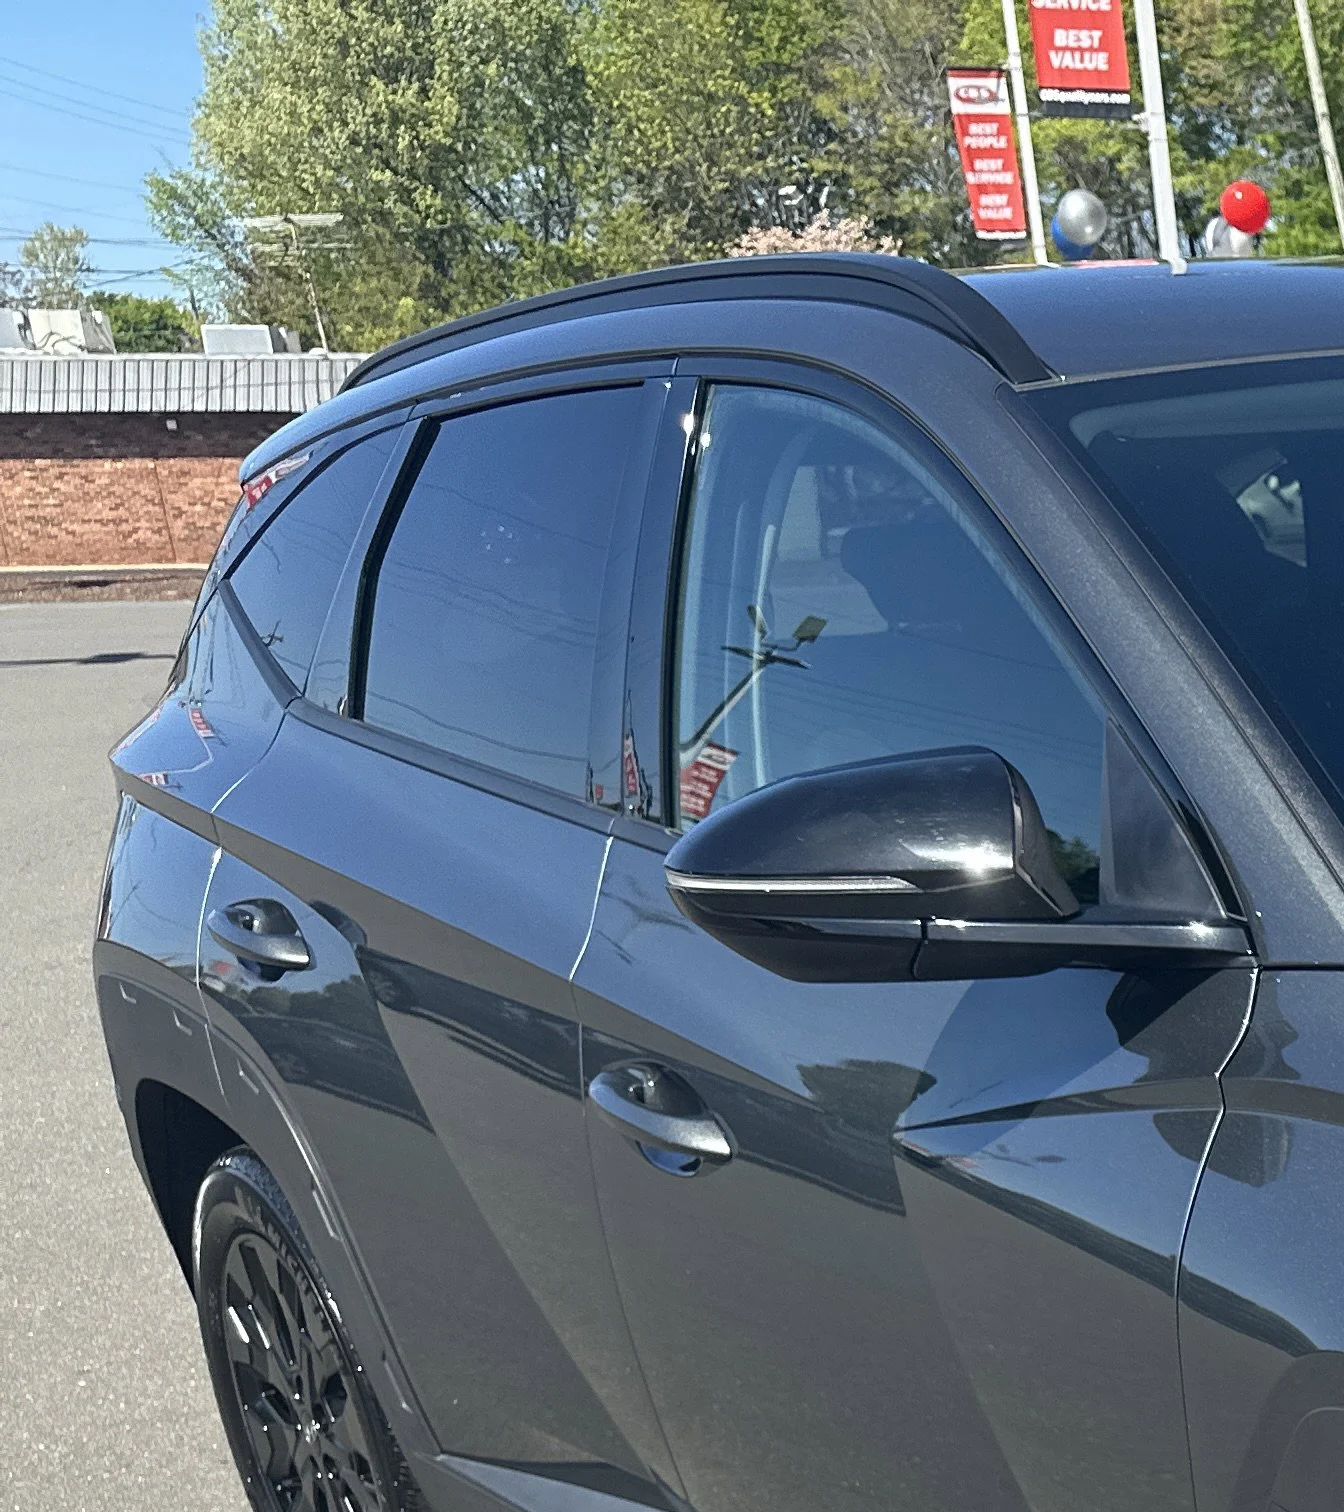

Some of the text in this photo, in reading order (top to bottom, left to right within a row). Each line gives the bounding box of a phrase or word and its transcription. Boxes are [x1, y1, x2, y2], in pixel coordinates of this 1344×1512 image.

[1053, 28, 1103, 49] BEST
[1048, 50, 1109, 71] VALUE
[968, 122, 999, 136] BEST
[963, 135, 1008, 149] PEOPLE
